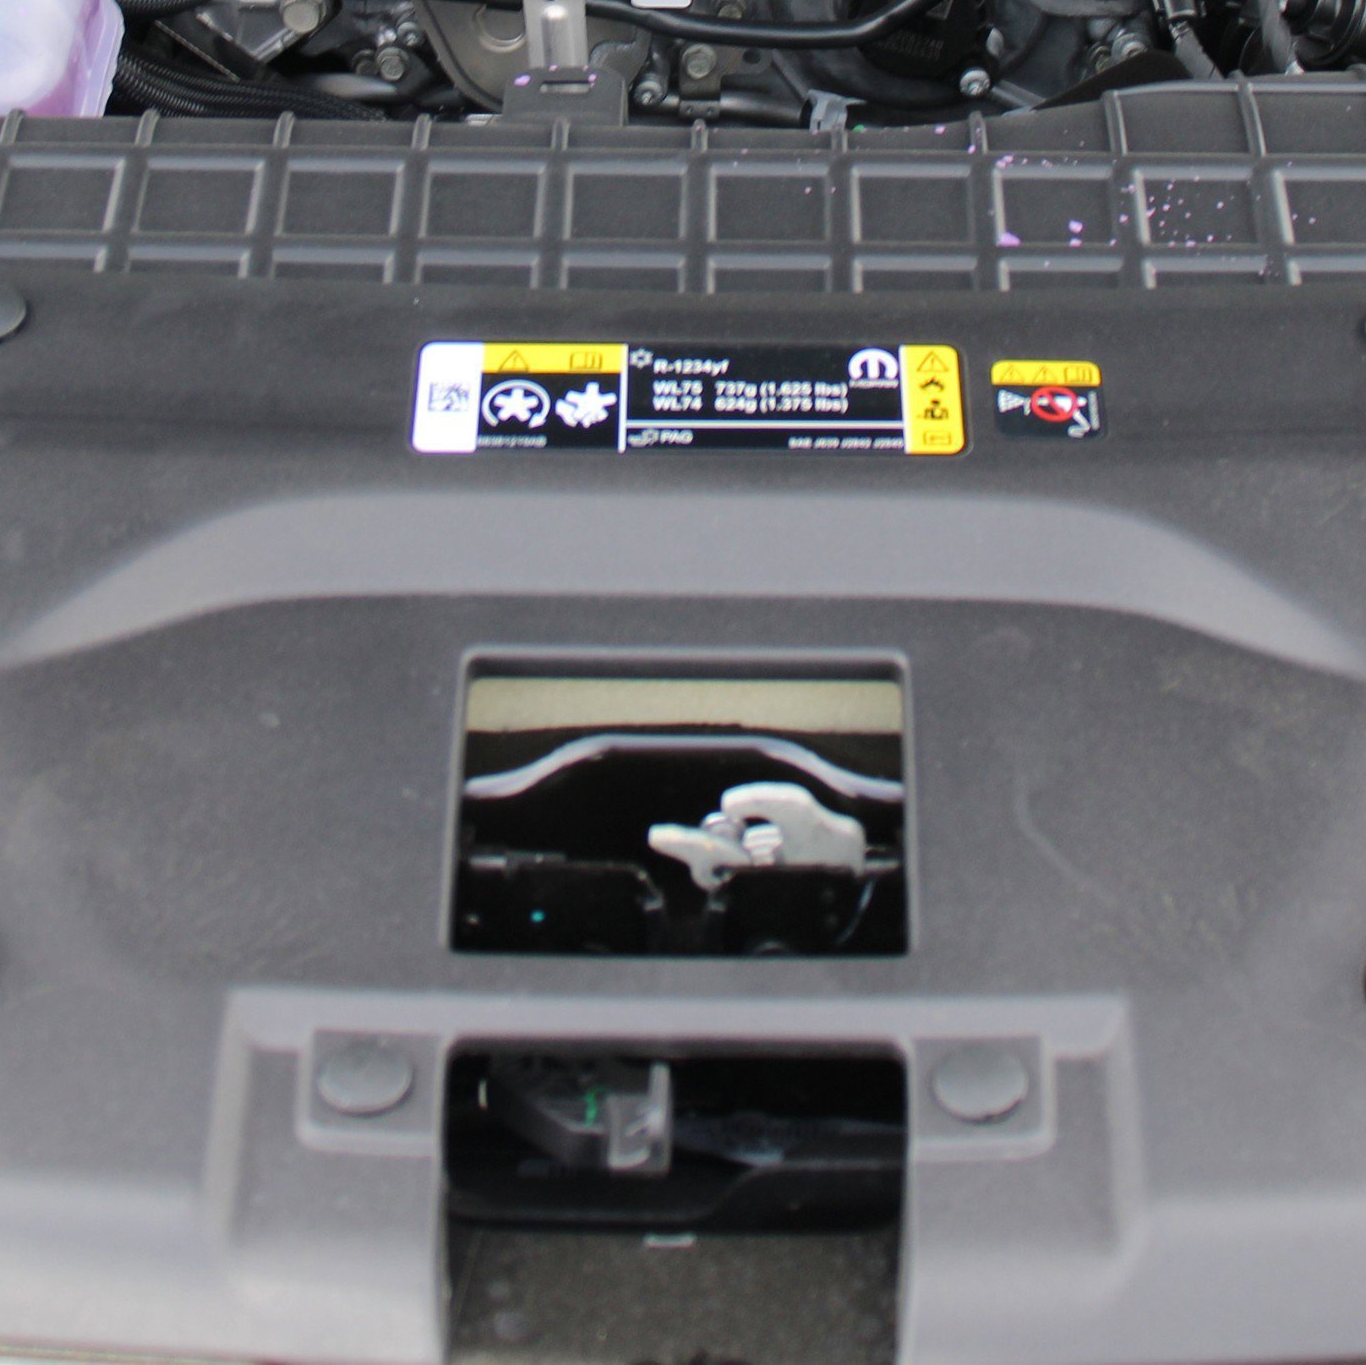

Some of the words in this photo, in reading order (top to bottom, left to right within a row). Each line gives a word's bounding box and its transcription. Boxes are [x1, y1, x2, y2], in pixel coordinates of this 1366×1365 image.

[653, 358, 729, 377] R-1234yf
[653, 380, 703, 396] WL75
[715, 381, 758, 398] 737g
[814, 380, 848, 398] lbs)
[652, 396, 703, 412] WL74
[714, 396, 757, 414] 624g
[814, 397, 849, 414] lbs)
